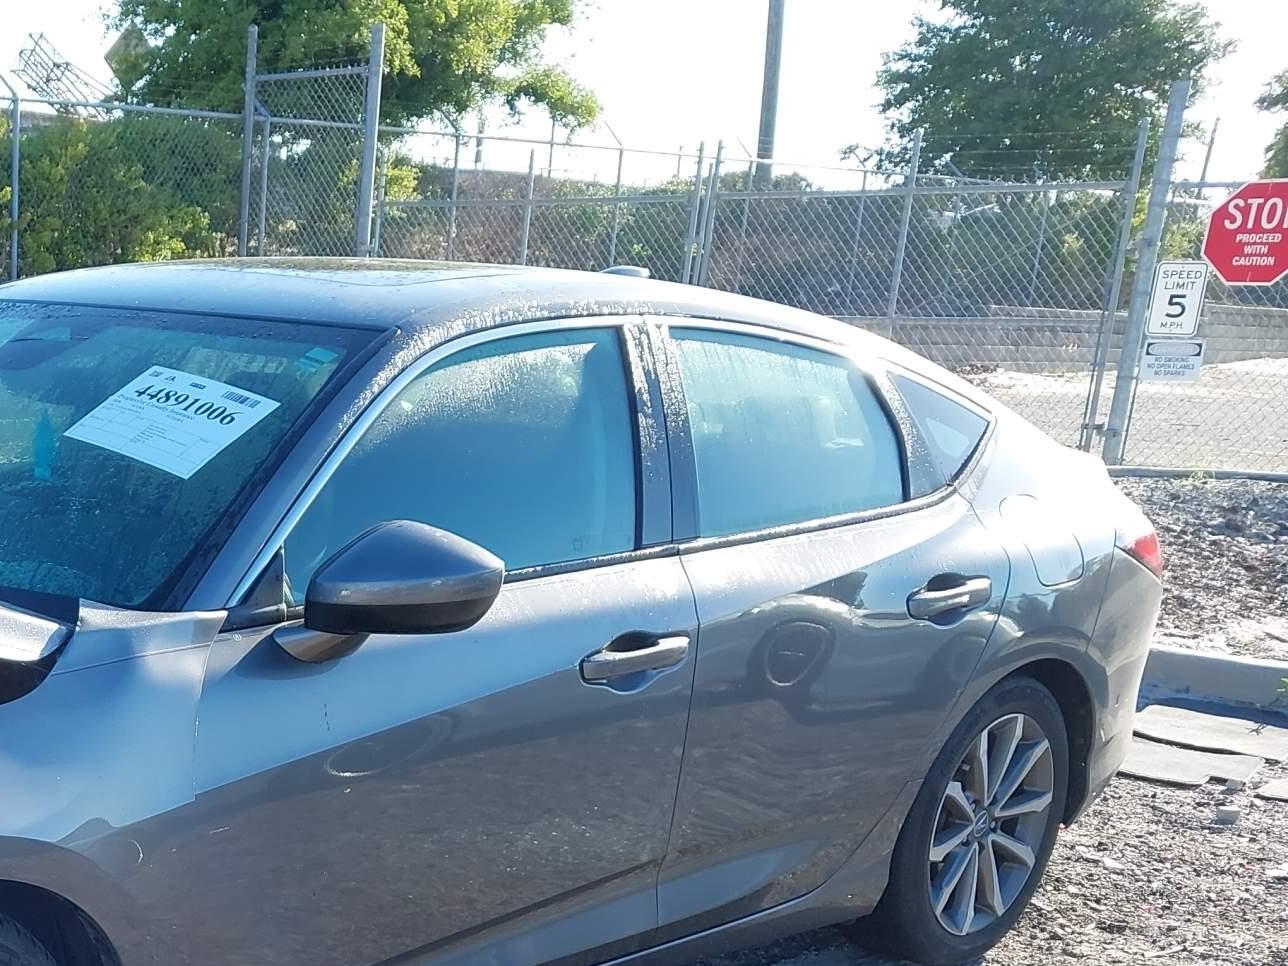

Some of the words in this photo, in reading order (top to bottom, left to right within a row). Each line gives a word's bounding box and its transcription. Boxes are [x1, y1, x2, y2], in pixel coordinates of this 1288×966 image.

[1235, 233, 1283, 243] PROCEED
[1244, 245, 1269, 254] WITH
[1232, 256, 1276, 266] CAUTION
[1162, 270, 1203, 279] SPEED
[1164, 281, 1197, 290] LIMIT
[1165, 294, 1187, 318] 5
[134, 384, 244, 425] 44891006
